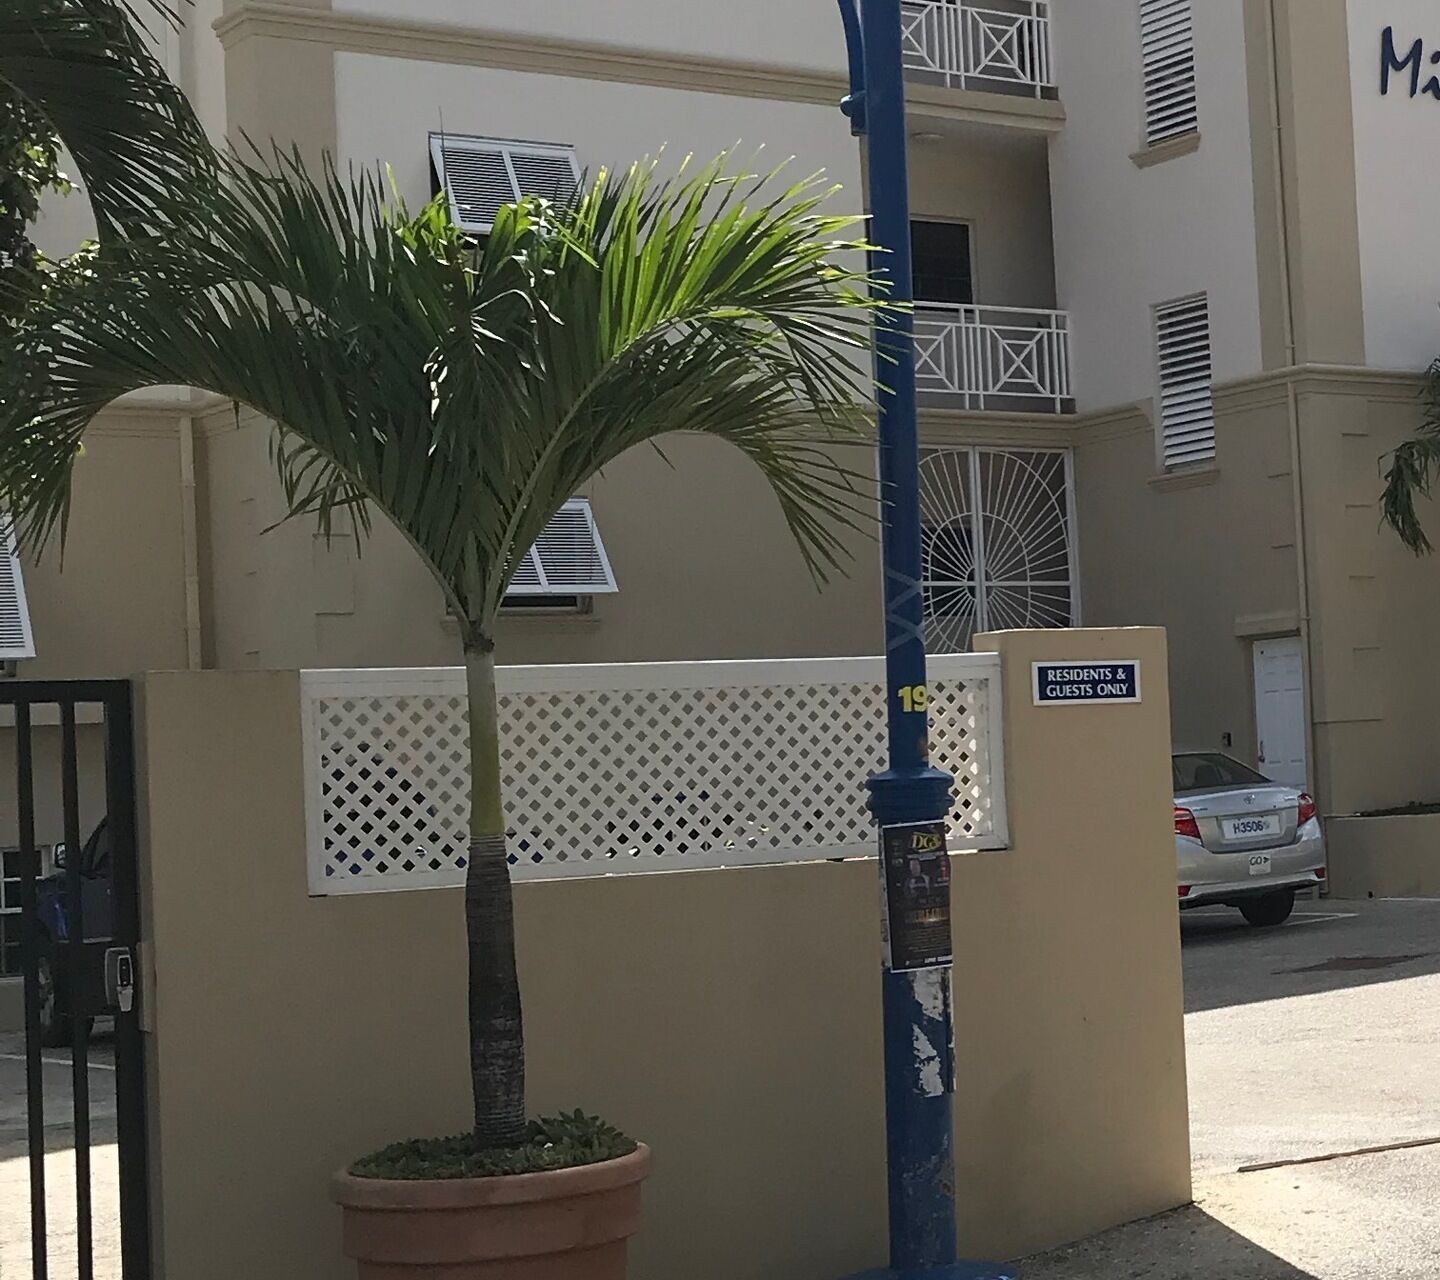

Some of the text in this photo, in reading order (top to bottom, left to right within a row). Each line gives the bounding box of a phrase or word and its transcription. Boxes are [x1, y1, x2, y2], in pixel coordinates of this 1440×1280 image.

[1047, 668, 1126, 681] RESIDENTS &
[1046, 683, 1128, 697] GUESTS ONLY
[897, 685, 928, 712] 19
